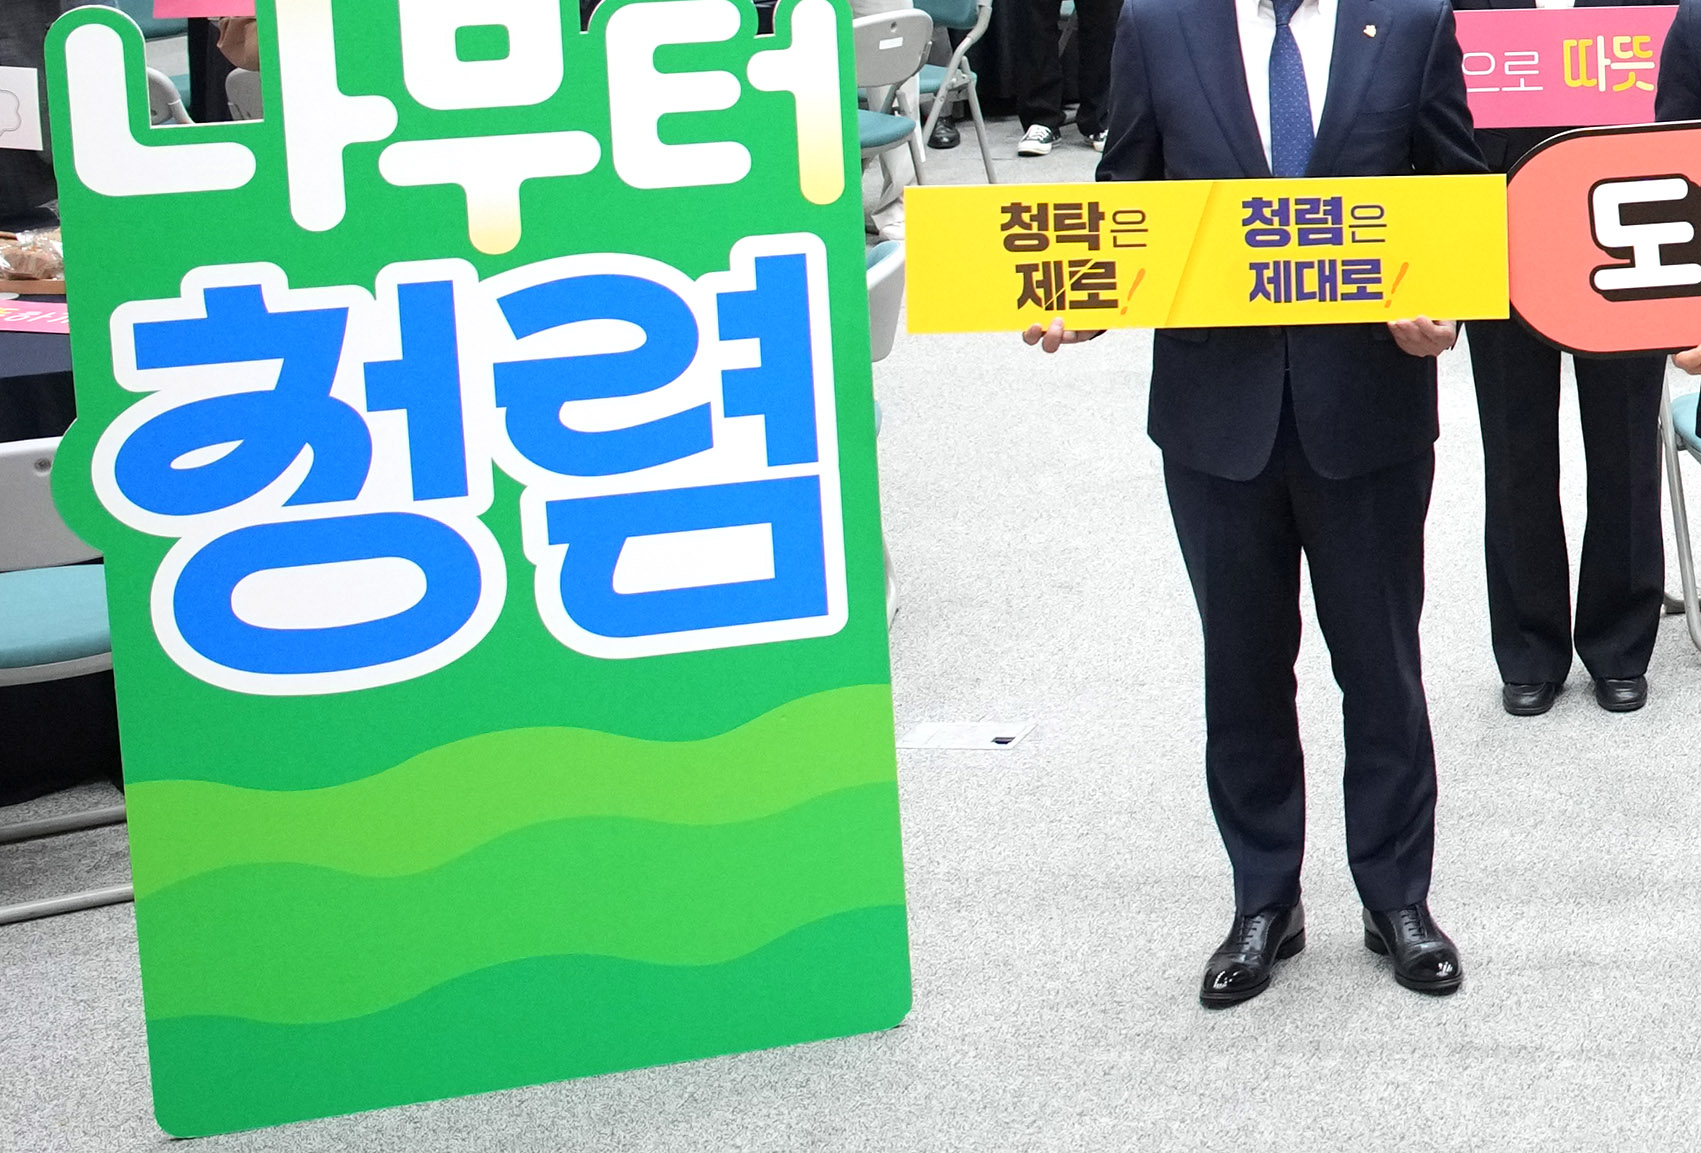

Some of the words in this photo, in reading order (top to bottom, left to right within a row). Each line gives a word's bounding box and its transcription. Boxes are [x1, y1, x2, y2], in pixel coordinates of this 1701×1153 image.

[1461, 50, 1544, 93] 으로
[1563, 35, 1656, 92] 따뜻
[1000, 201, 1149, 253] 청탁은
[1241, 196, 1388, 248] 청렴은
[1015, 258, 1146, 315] 제로!
[1249, 259, 1409, 308] 제대로!
[105, 244, 838, 686] 청렴
